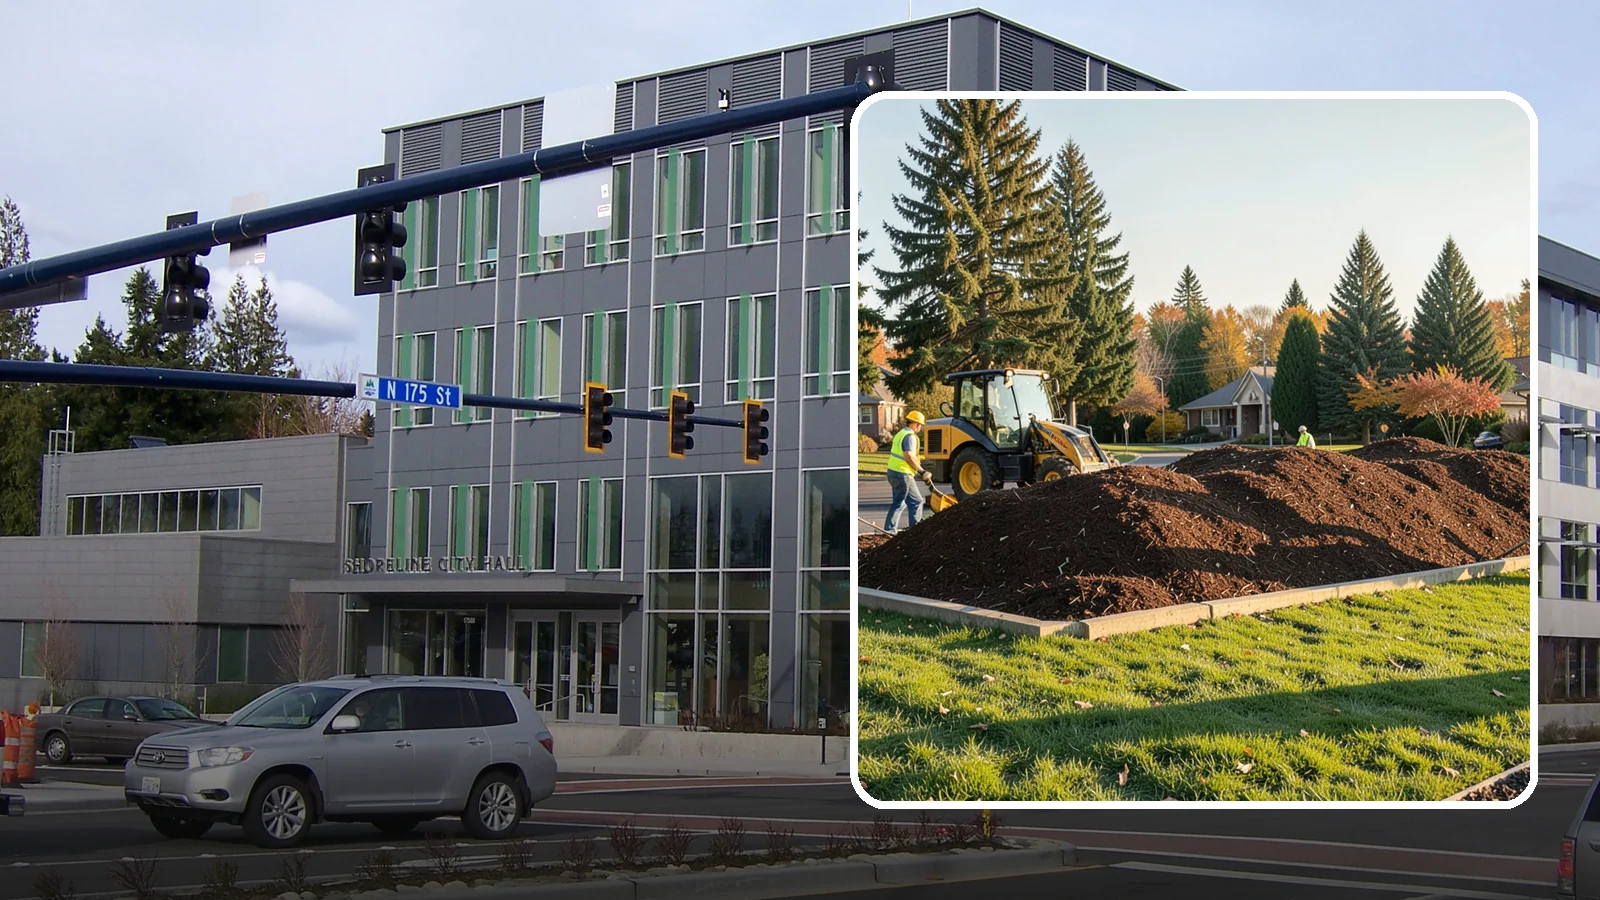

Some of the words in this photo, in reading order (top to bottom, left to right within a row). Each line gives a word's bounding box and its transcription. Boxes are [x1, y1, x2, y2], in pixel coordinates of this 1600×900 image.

[387, 381, 396, 399] N
[405, 382, 427, 403] 175
[436, 386, 451, 405] St
[344, 557, 432, 573] SHORELINE
[438, 556, 475, 572] CITY
[483, 555, 525, 571] HALL
